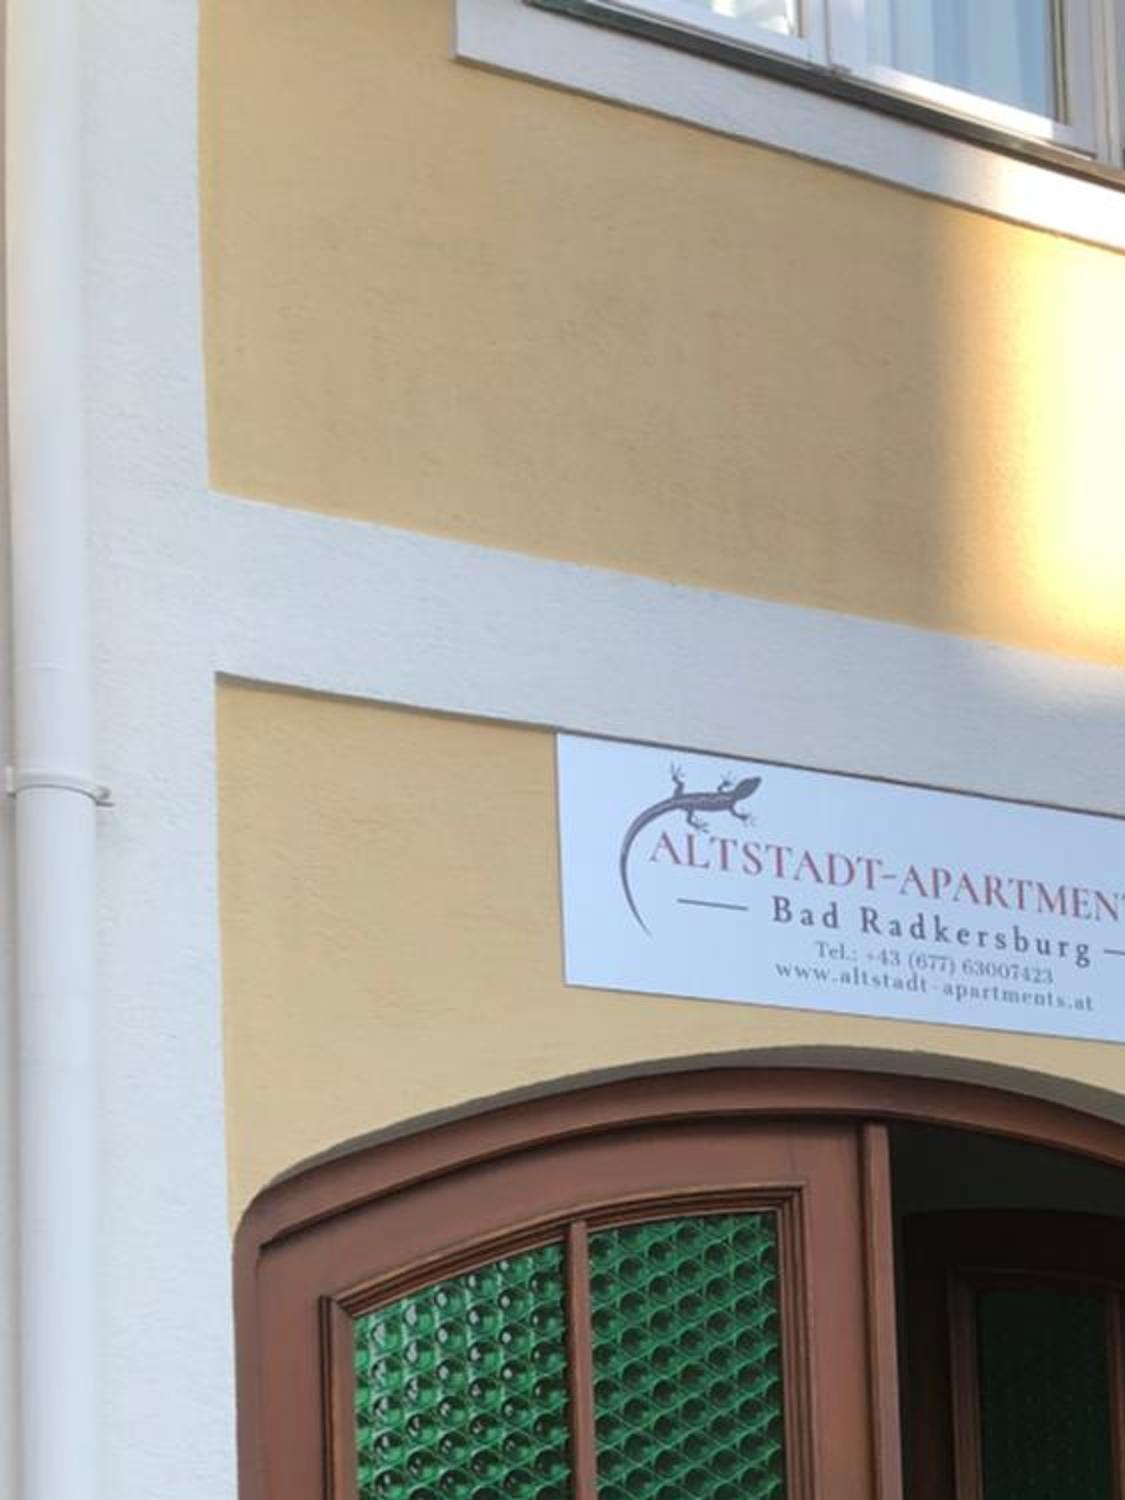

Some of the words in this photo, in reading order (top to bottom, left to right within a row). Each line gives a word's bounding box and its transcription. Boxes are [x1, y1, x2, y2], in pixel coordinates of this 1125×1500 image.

[772, 895, 840, 930] Bad
[860, 906, 1092, 969] Radkersburg
[775, 961, 1095, 1012] www.altstadt-apartments.at
[815, 941, 857, 961] Tel.:
[866, 949, 900, 966] +43
[908, 949, 955, 976] (677)
[962, 956, 1054, 985] 63007423
